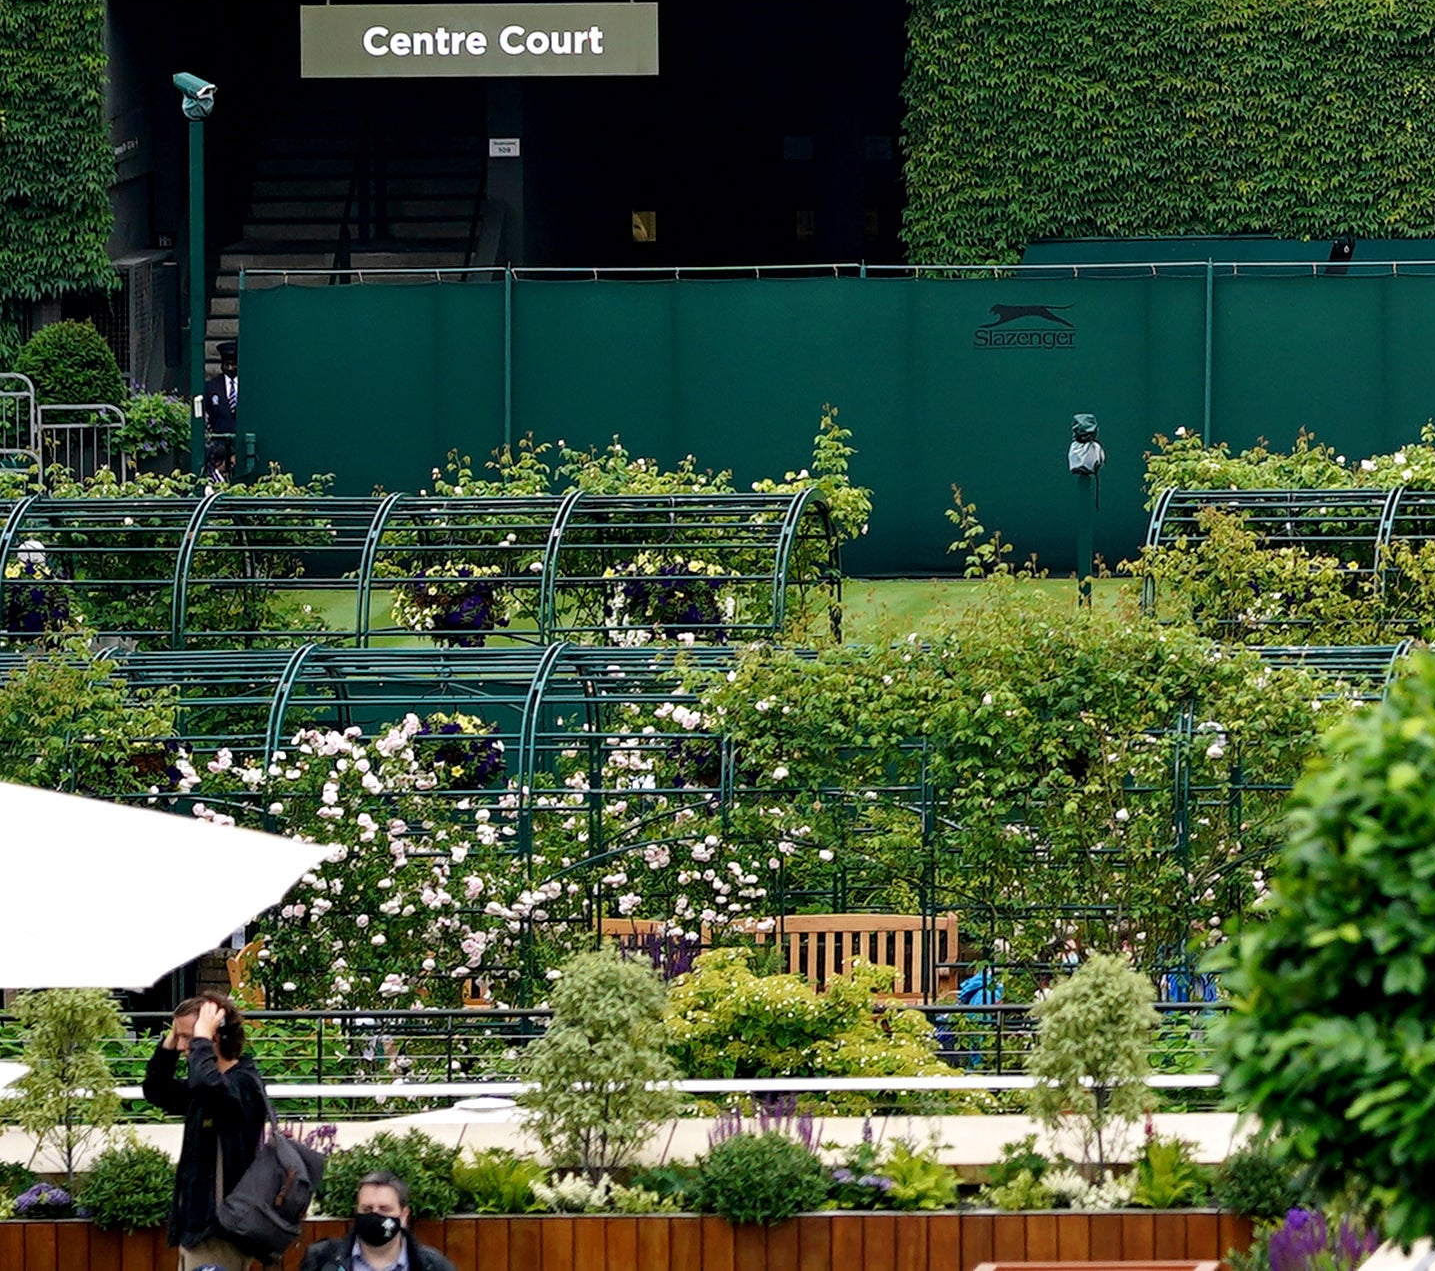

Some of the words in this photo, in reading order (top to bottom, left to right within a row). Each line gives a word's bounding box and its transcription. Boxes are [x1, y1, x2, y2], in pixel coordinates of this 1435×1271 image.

[362, 25, 488, 58] Centre
[498, 24, 604, 57] Court
[973, 329, 1076, 350] Slazenger
